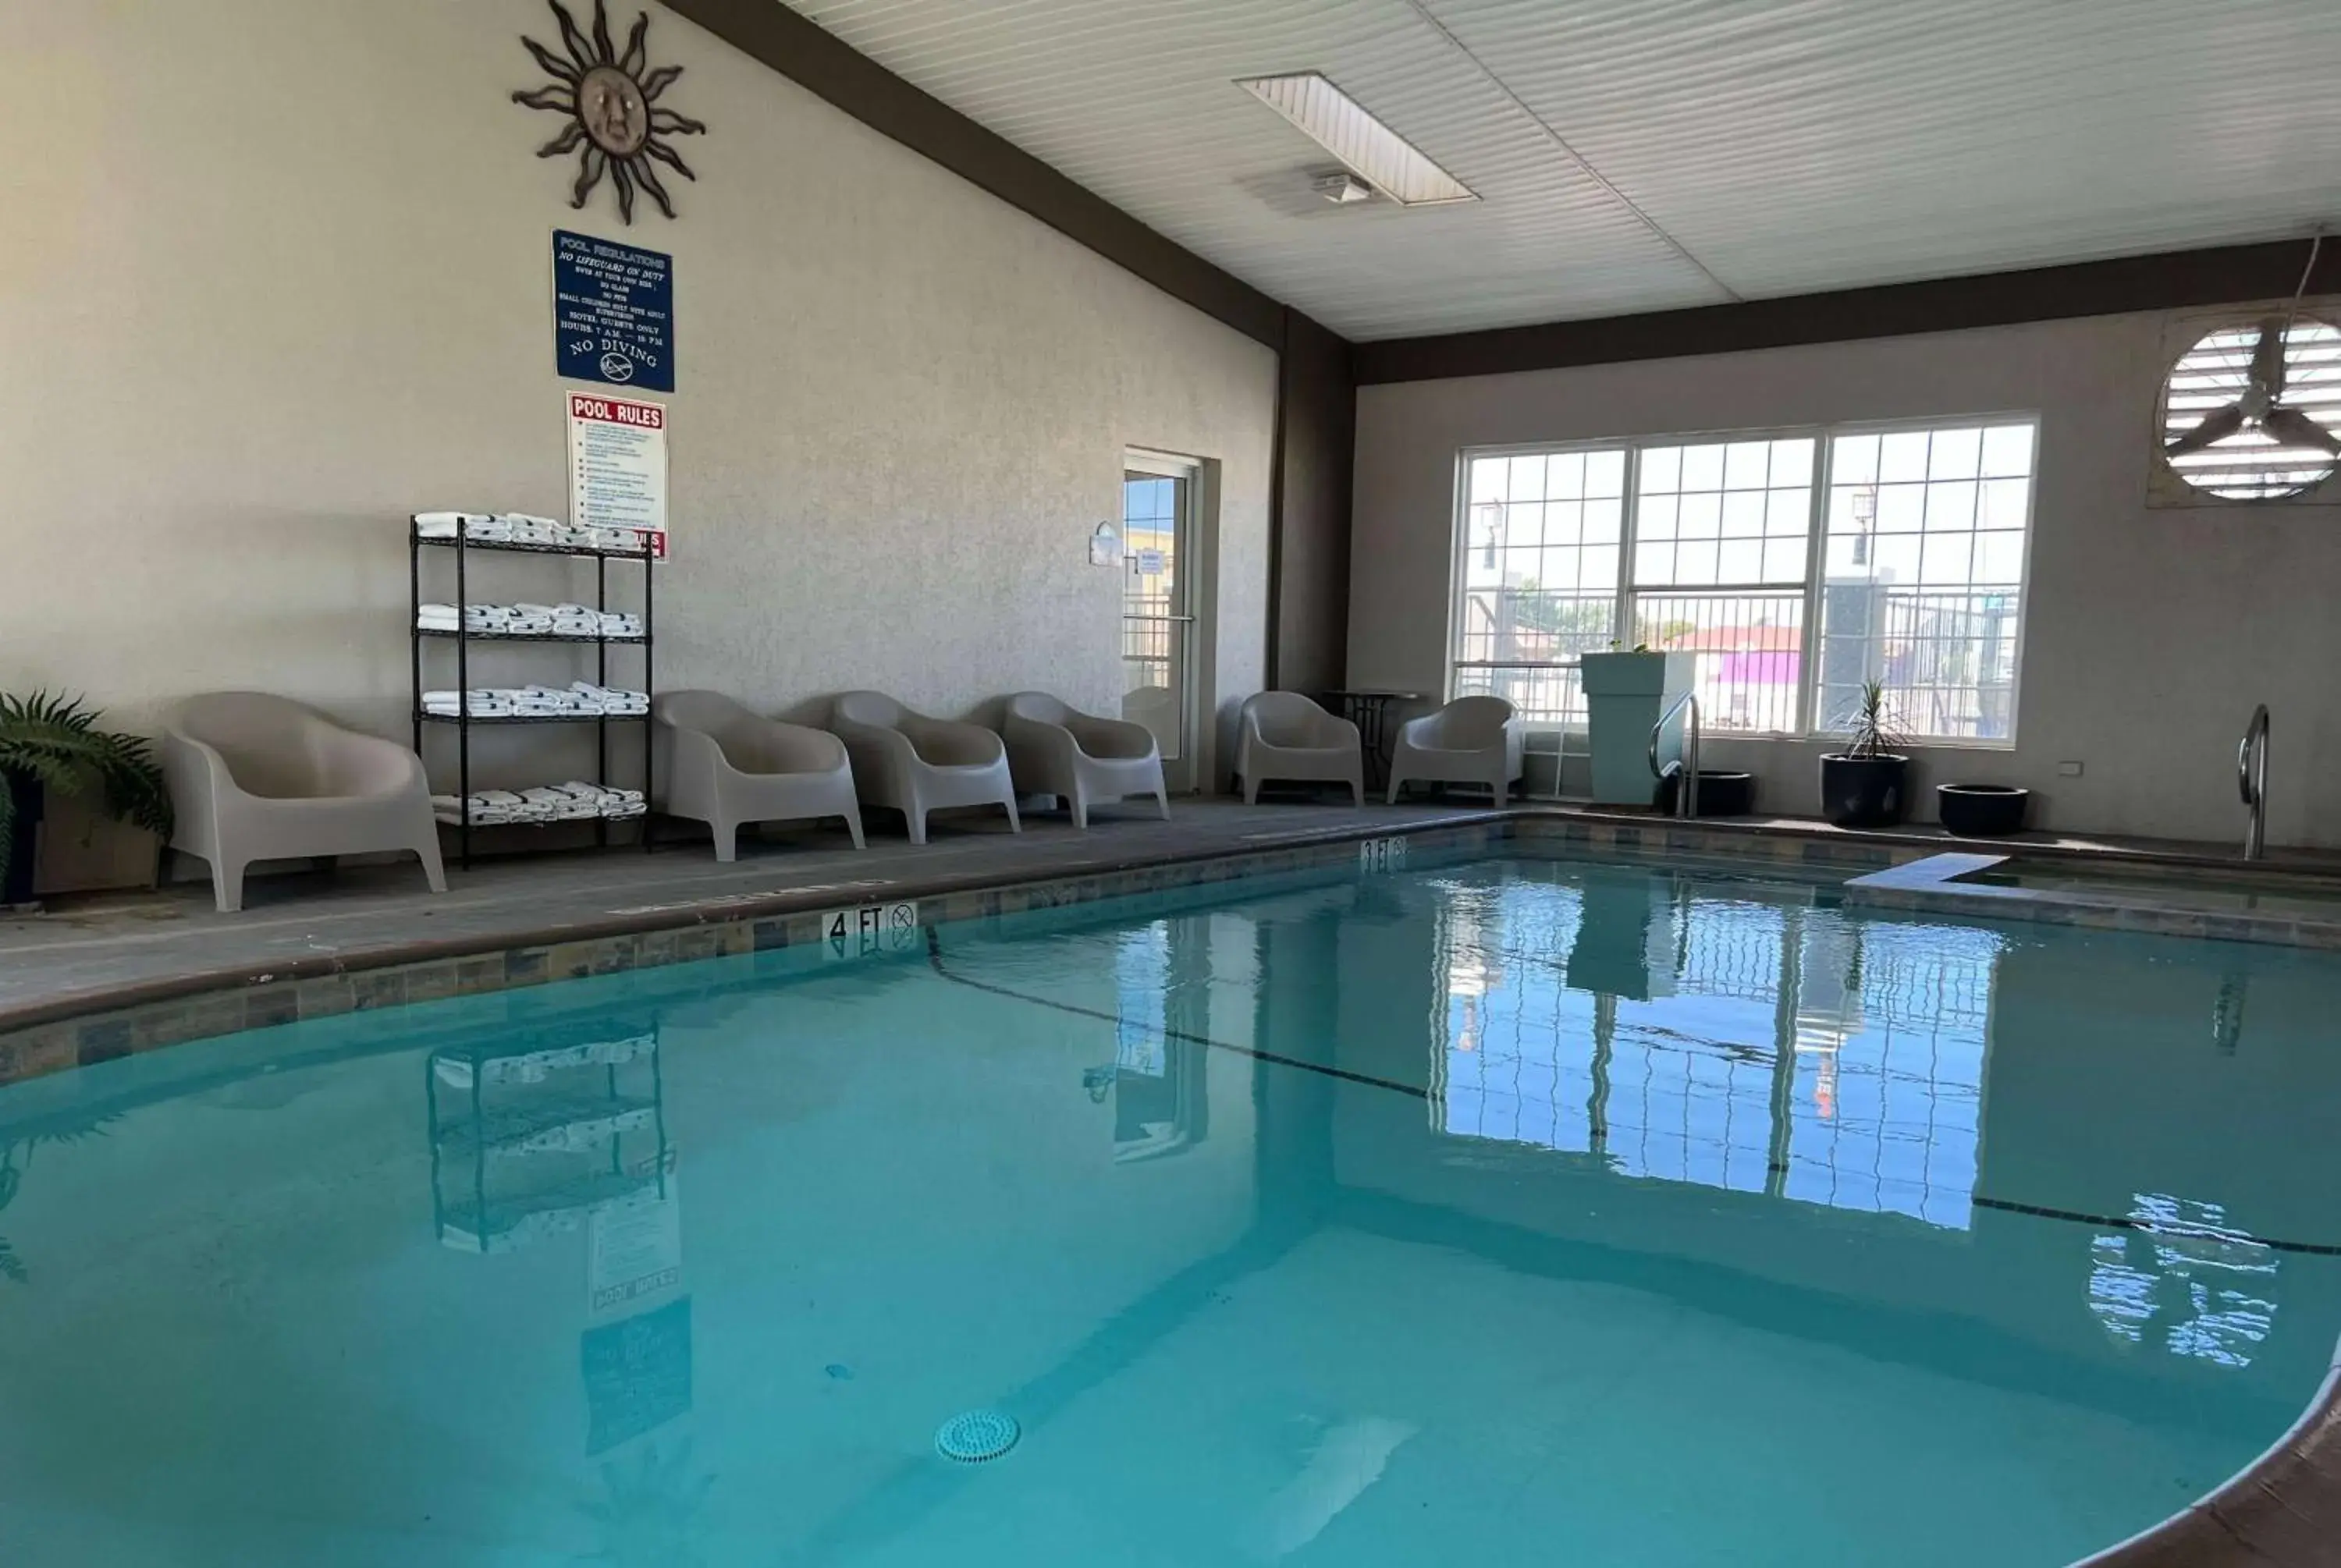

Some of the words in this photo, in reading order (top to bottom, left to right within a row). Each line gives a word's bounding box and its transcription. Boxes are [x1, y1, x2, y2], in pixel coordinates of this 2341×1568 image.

[559, 251, 573, 261] NO
[575, 255, 625, 272] LIFEGUARD
[627, 266, 640, 275] ON
[643, 270, 665, 281] DUTY
[560, 236, 591, 253] POOL
[594, 244, 666, 270] REGULATIONS
[636, 324, 659, 334] ONLY
[570, 339, 594, 357] NO
[601, 338, 658, 367] DIVING
[574, 398, 613, 420] POOL
[616, 404, 660, 427] RULES
[829, 912, 847, 938] 4
[859, 907, 883, 935] FT
